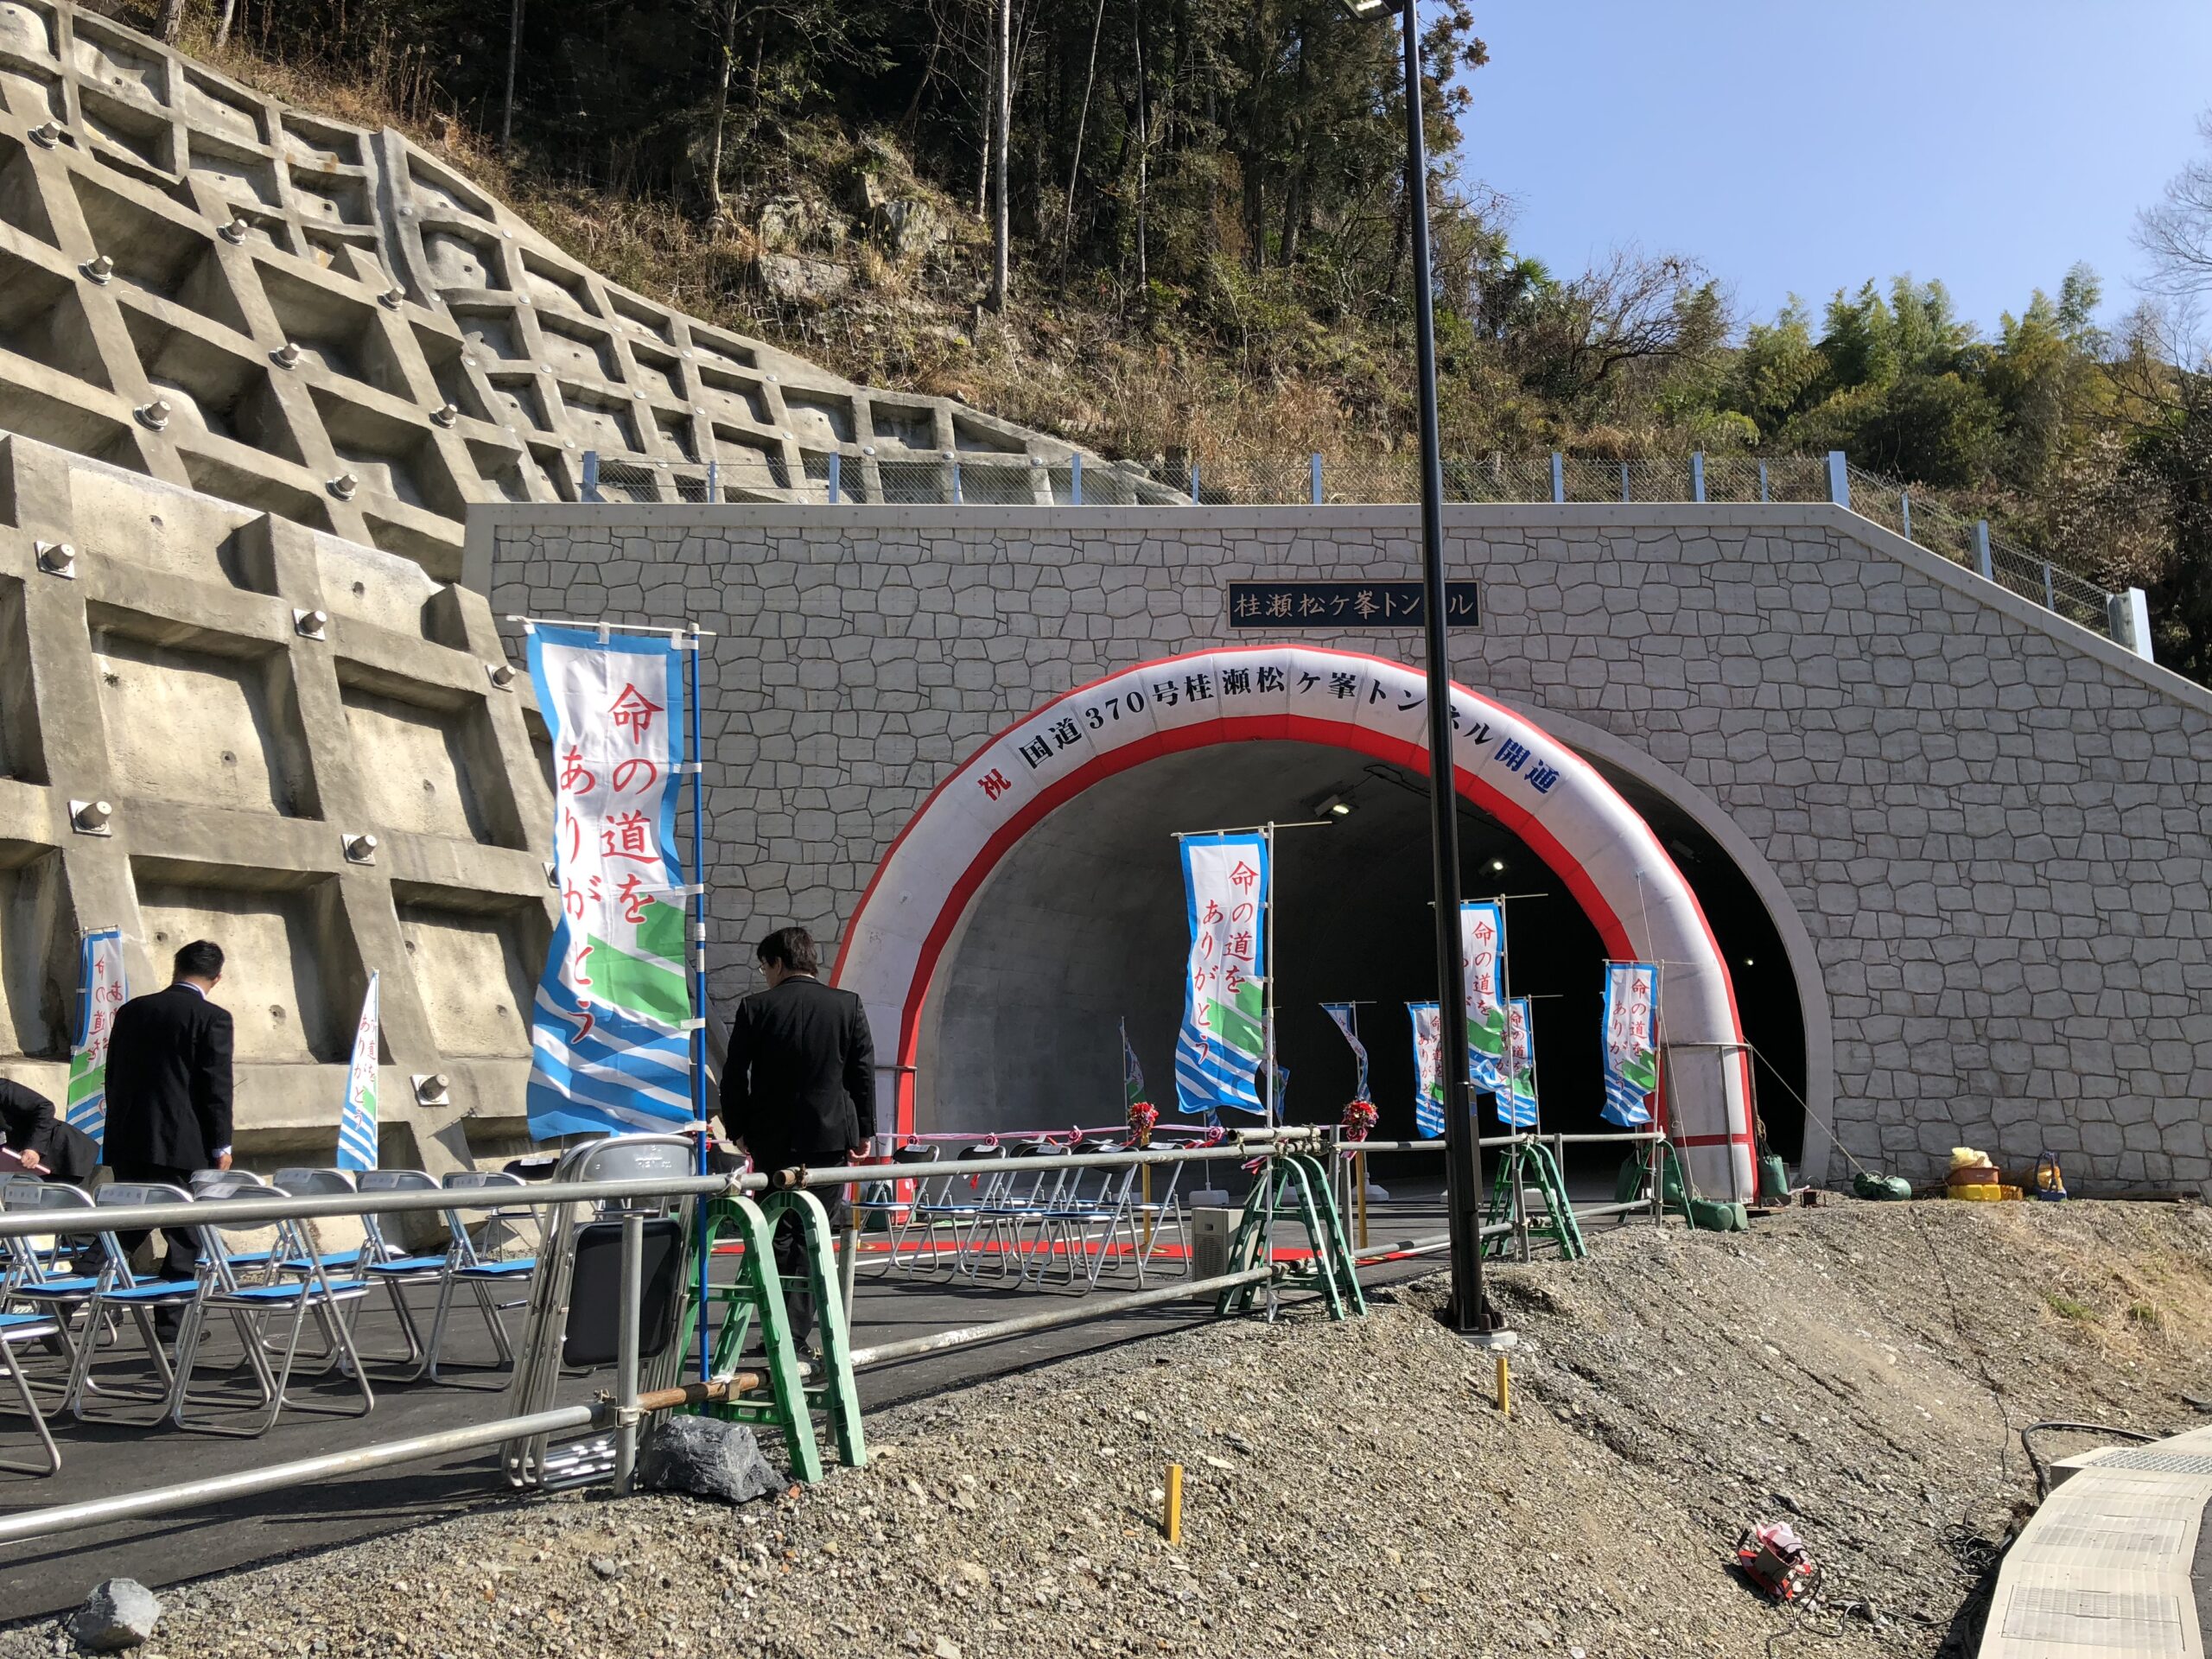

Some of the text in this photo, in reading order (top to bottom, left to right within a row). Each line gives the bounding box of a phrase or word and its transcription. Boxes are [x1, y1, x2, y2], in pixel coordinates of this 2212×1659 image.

[1234, 590, 1473, 620] 桂瀬松ケ峯トンル
[601, 683, 664, 924] 命の道を
[561, 744, 601, 1046] ありがとう
[1223, 861, 1258, 994] 命の道を
[1194, 899, 1224, 1065] ありがとう
[1472, 921, 1496, 1016] 命の道を
[1630, 978, 1649, 1057] 命の道を
[354, 1014, 369, 1130] ありがとう
[1510, 1011, 1528, 1072] 命の道を
[1610, 1001, 1628, 1091] ありがとう
